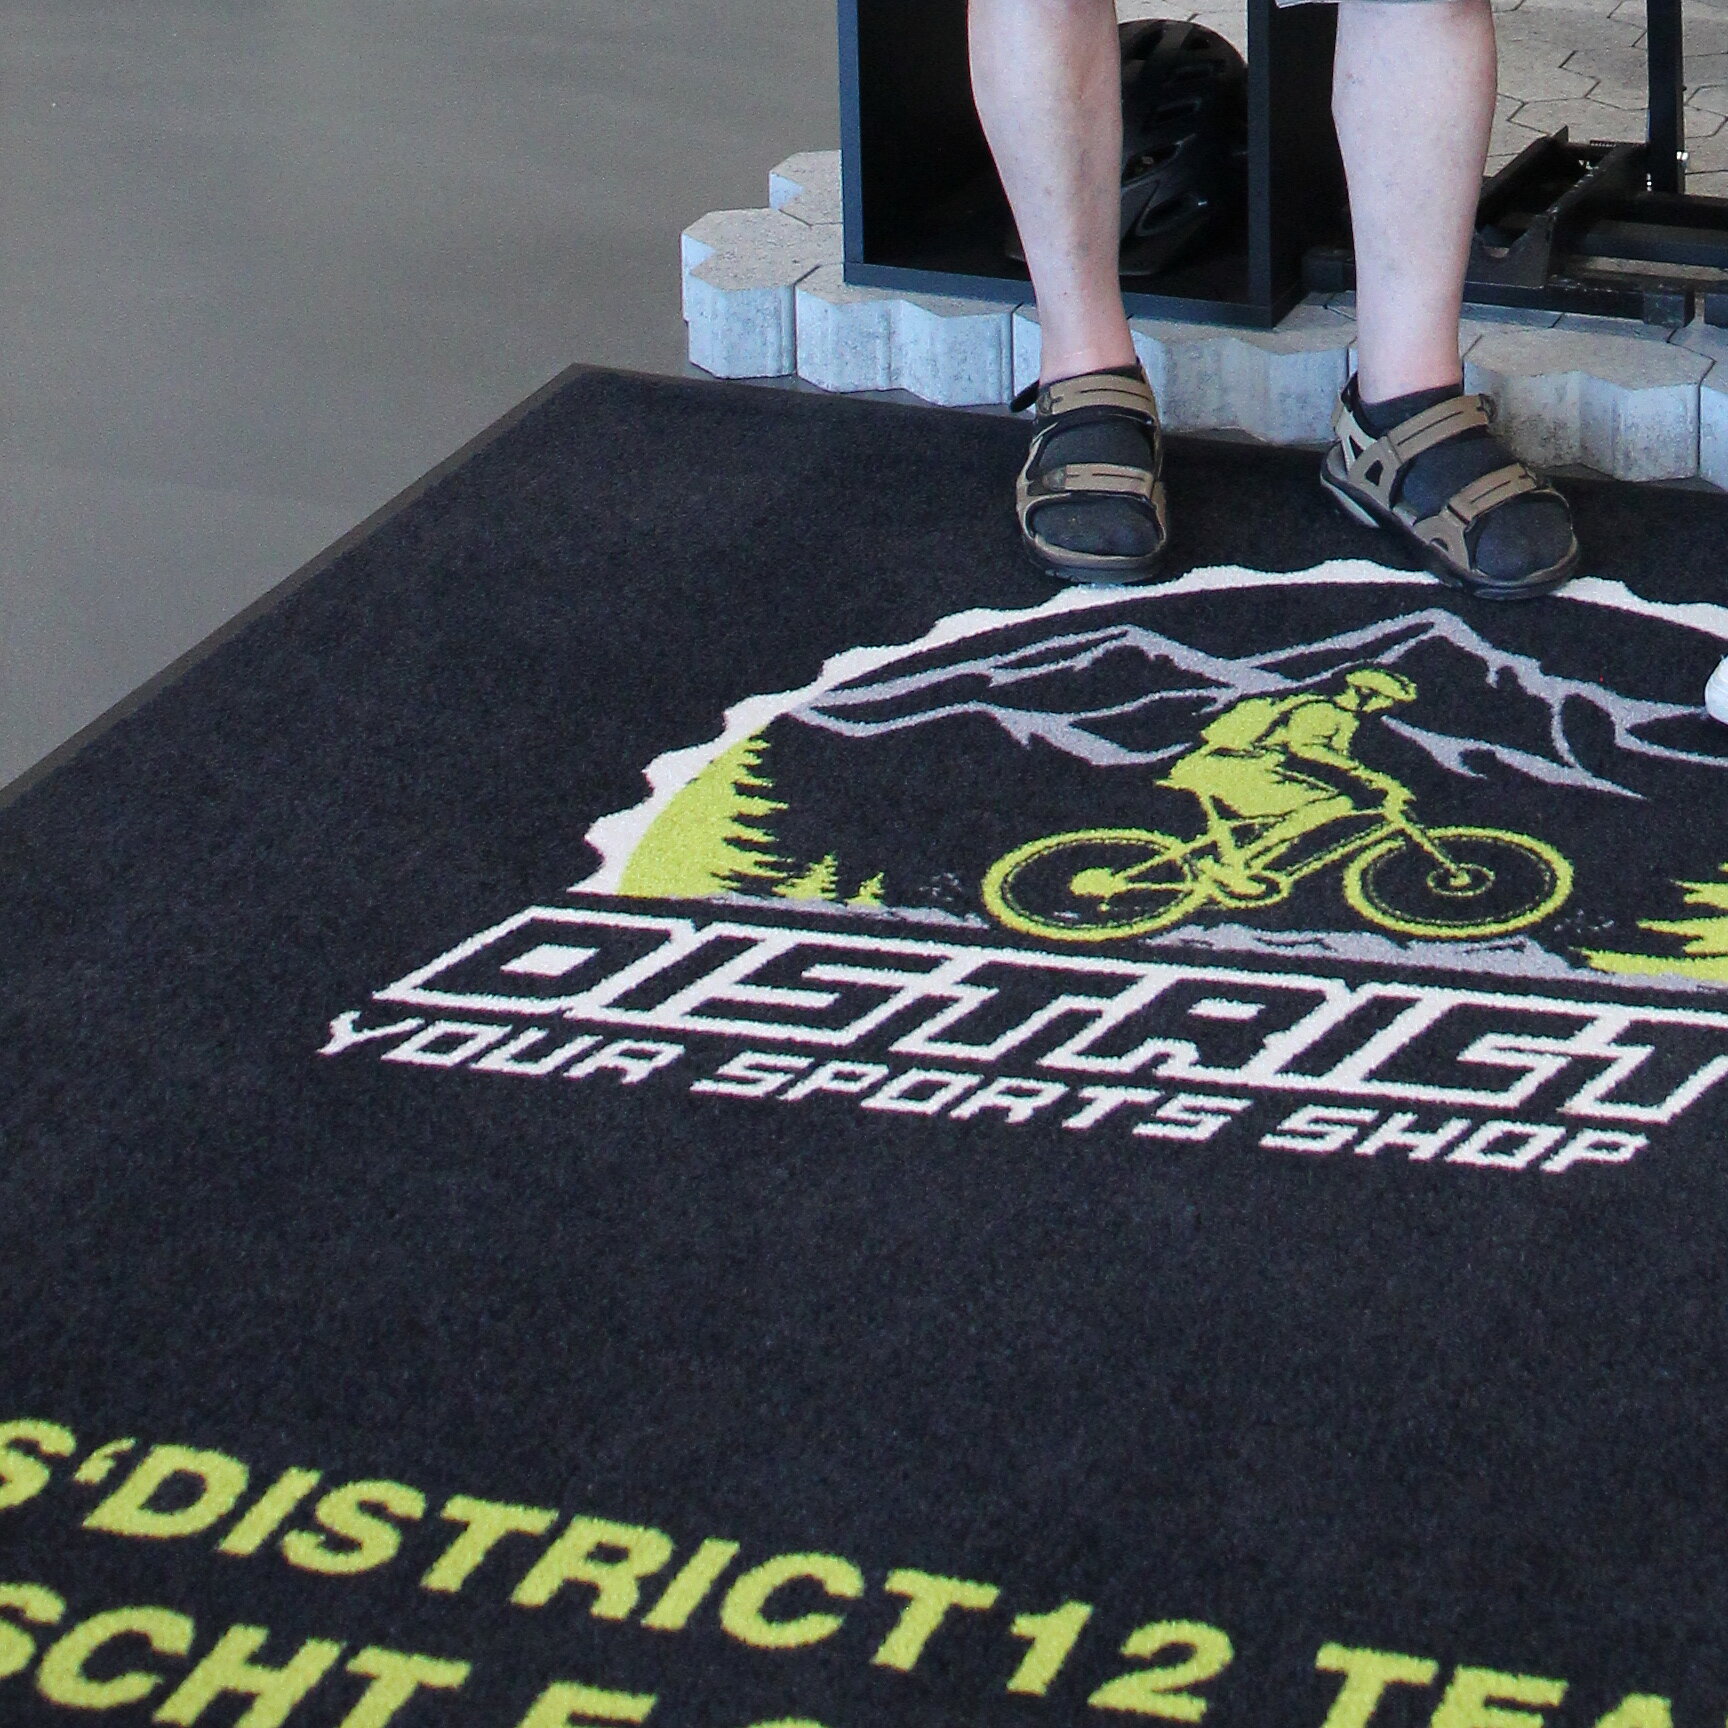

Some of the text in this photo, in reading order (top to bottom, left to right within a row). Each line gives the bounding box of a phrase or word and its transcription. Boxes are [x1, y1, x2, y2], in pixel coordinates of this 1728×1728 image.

[316, 1009, 1651, 1174] YOUR SPORTS SHOP
